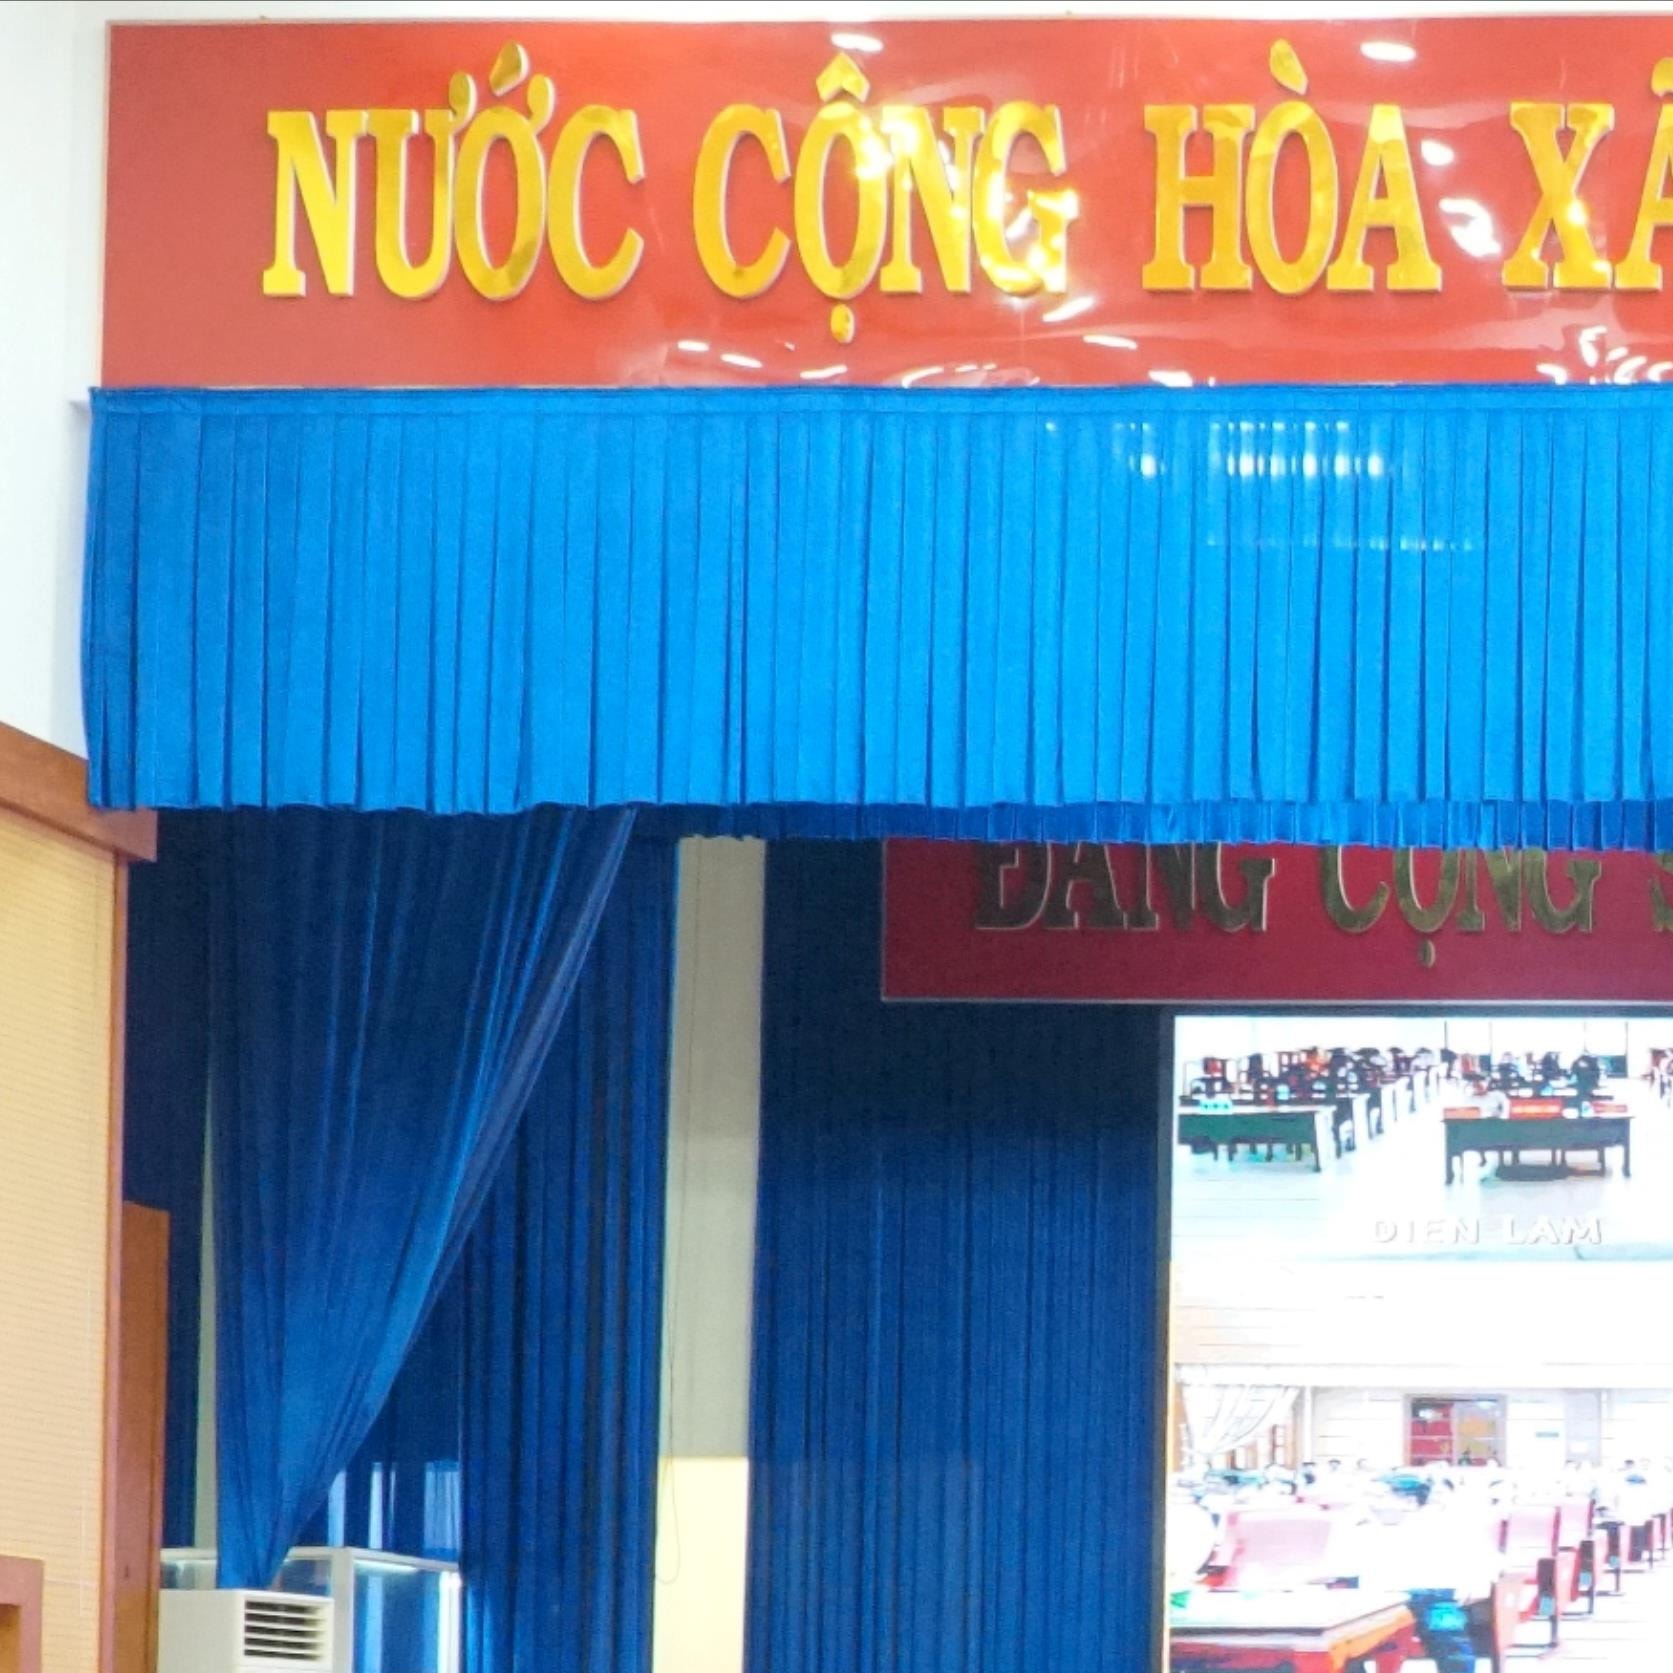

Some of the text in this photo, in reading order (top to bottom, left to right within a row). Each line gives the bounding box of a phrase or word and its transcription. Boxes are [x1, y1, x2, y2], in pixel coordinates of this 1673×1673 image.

[262, 40, 644, 302] NƯỚC
[692, 50, 1079, 344] CỘNG
[1142, 38, 1442, 298] HÒA
